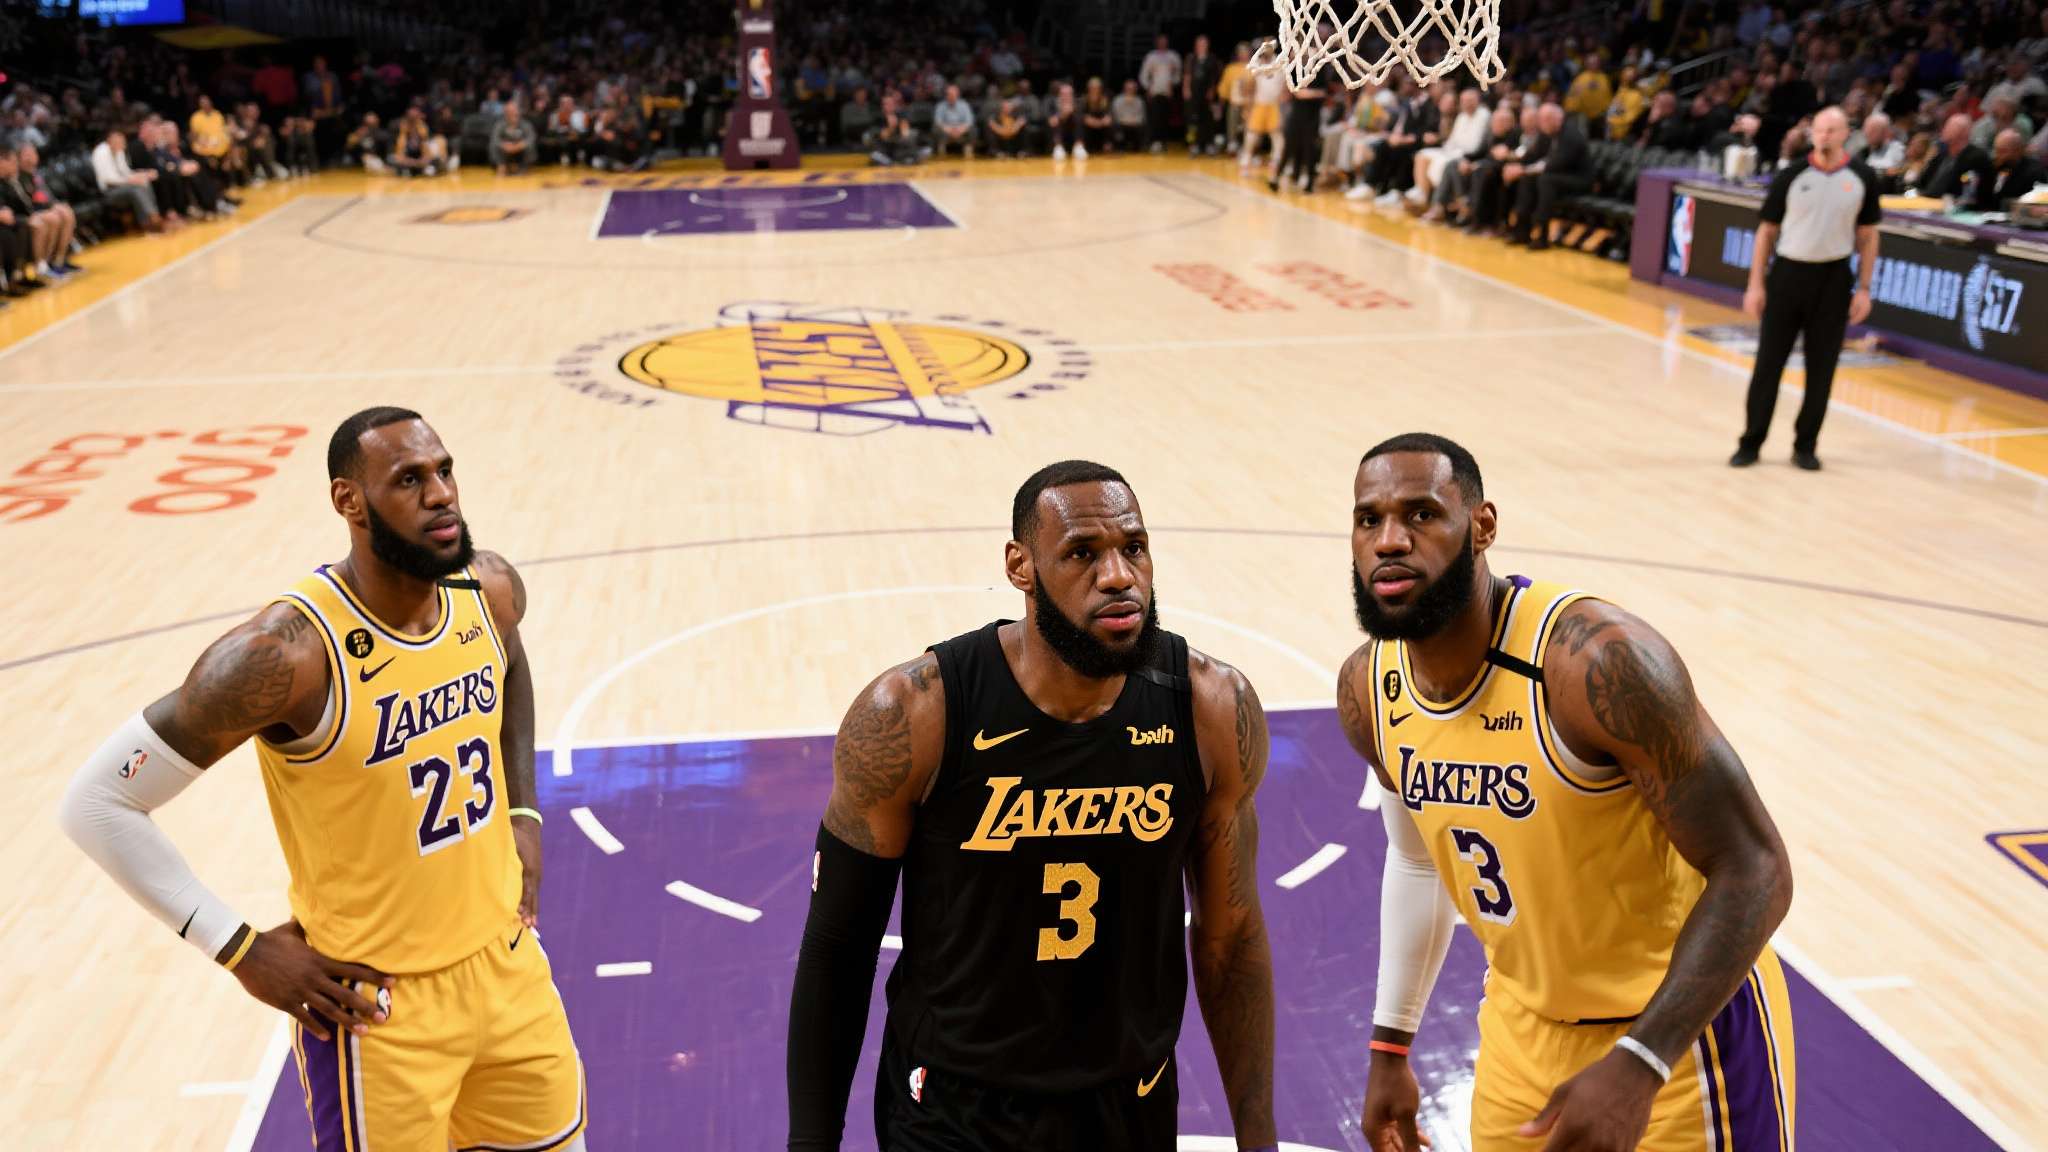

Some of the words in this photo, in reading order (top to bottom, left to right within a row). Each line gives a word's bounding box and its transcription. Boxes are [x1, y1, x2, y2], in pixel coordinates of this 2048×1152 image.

[364, 664, 498, 768] LAKERS
[407, 736, 497, 857] 23
[960, 775, 1174, 852] LAKERS
[1397, 744, 1537, 820] LAKERS
[1036, 862, 1101, 962] 3
[1449, 826, 1518, 927] 3
